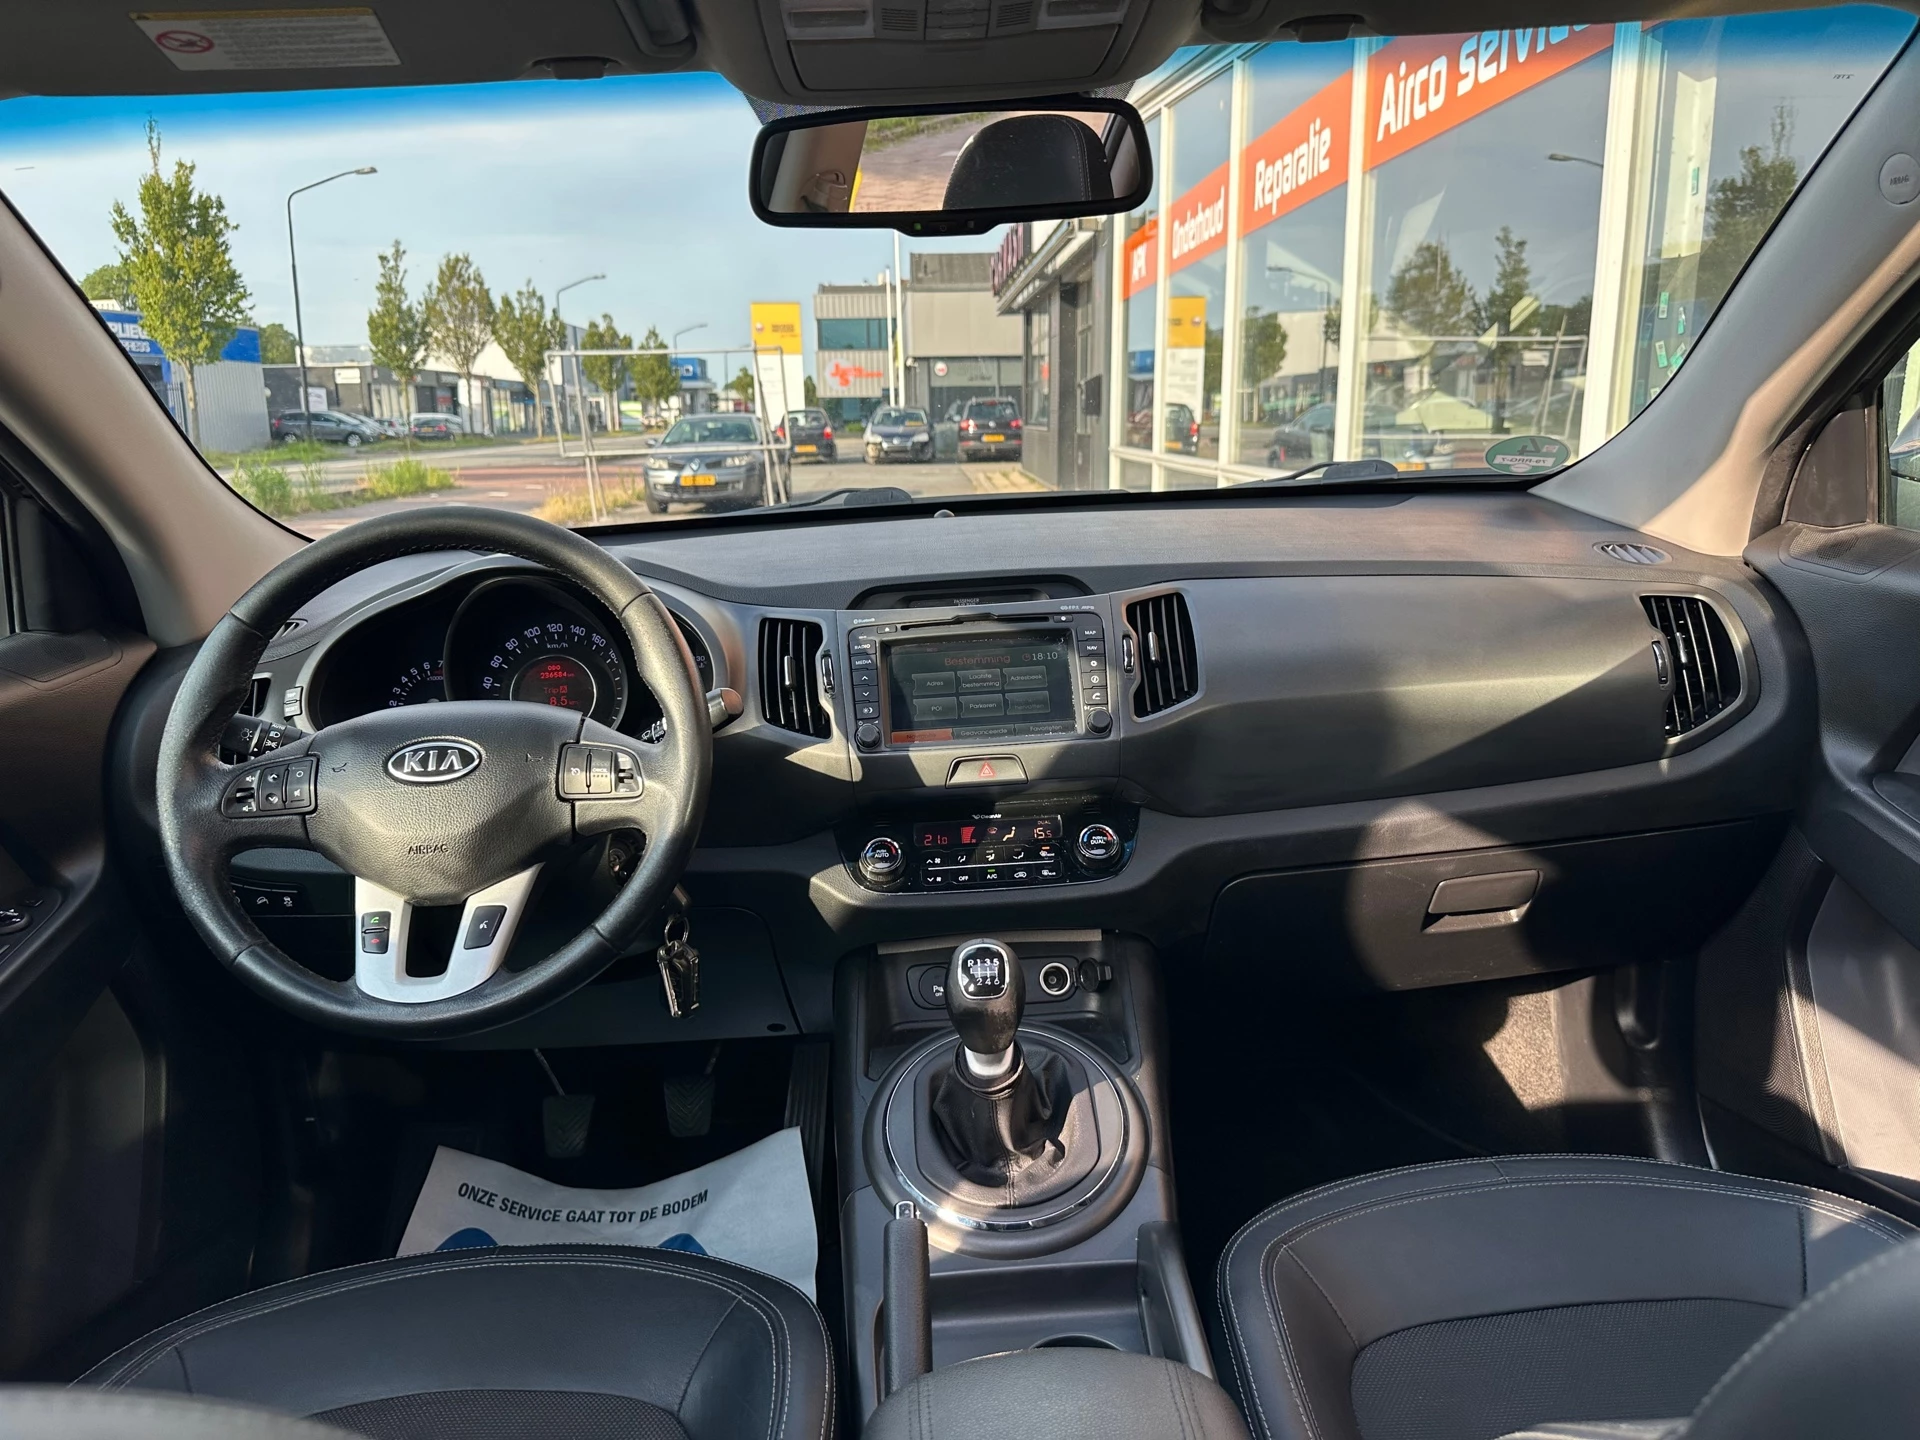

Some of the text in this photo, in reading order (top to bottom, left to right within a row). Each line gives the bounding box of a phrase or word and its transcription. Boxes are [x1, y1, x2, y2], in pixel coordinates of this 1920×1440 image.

[1376, 55, 1448, 143] Airco
[1253, 117, 1332, 216] Reparatie
[1171, 184, 1225, 260] Onderhoud
[1132, 242, 1148, 284] APK
[524, 626, 541, 639] 100
[546, 623, 563, 632] 120
[569, 624, 586, 636] 140
[505, 638, 518, 651] 80
[591, 633, 607, 647] 160
[490, 655, 503, 668] 60
[944, 654, 1011, 667] Bestemming
[1031, 651, 1058, 661] 18:10
[423, 661, 431, 670] 6
[437, 660, 444, 668] 7
[410, 667, 418, 676] 5
[401, 675, 409, 684] 4
[482, 676, 493, 690] 40
[962, 680, 1000, 688] bestemming
[550, 696, 568, 706] 8.5
[403, 749, 463, 773] KIA
[407, 843, 449, 855] AIRBAG
[967, 958, 1000, 968] R 1 3 5
[976, 978, 983, 986] 2
[458, 1181, 709, 1223] ONZE SERVICE GAAT TOT DE BODEM
